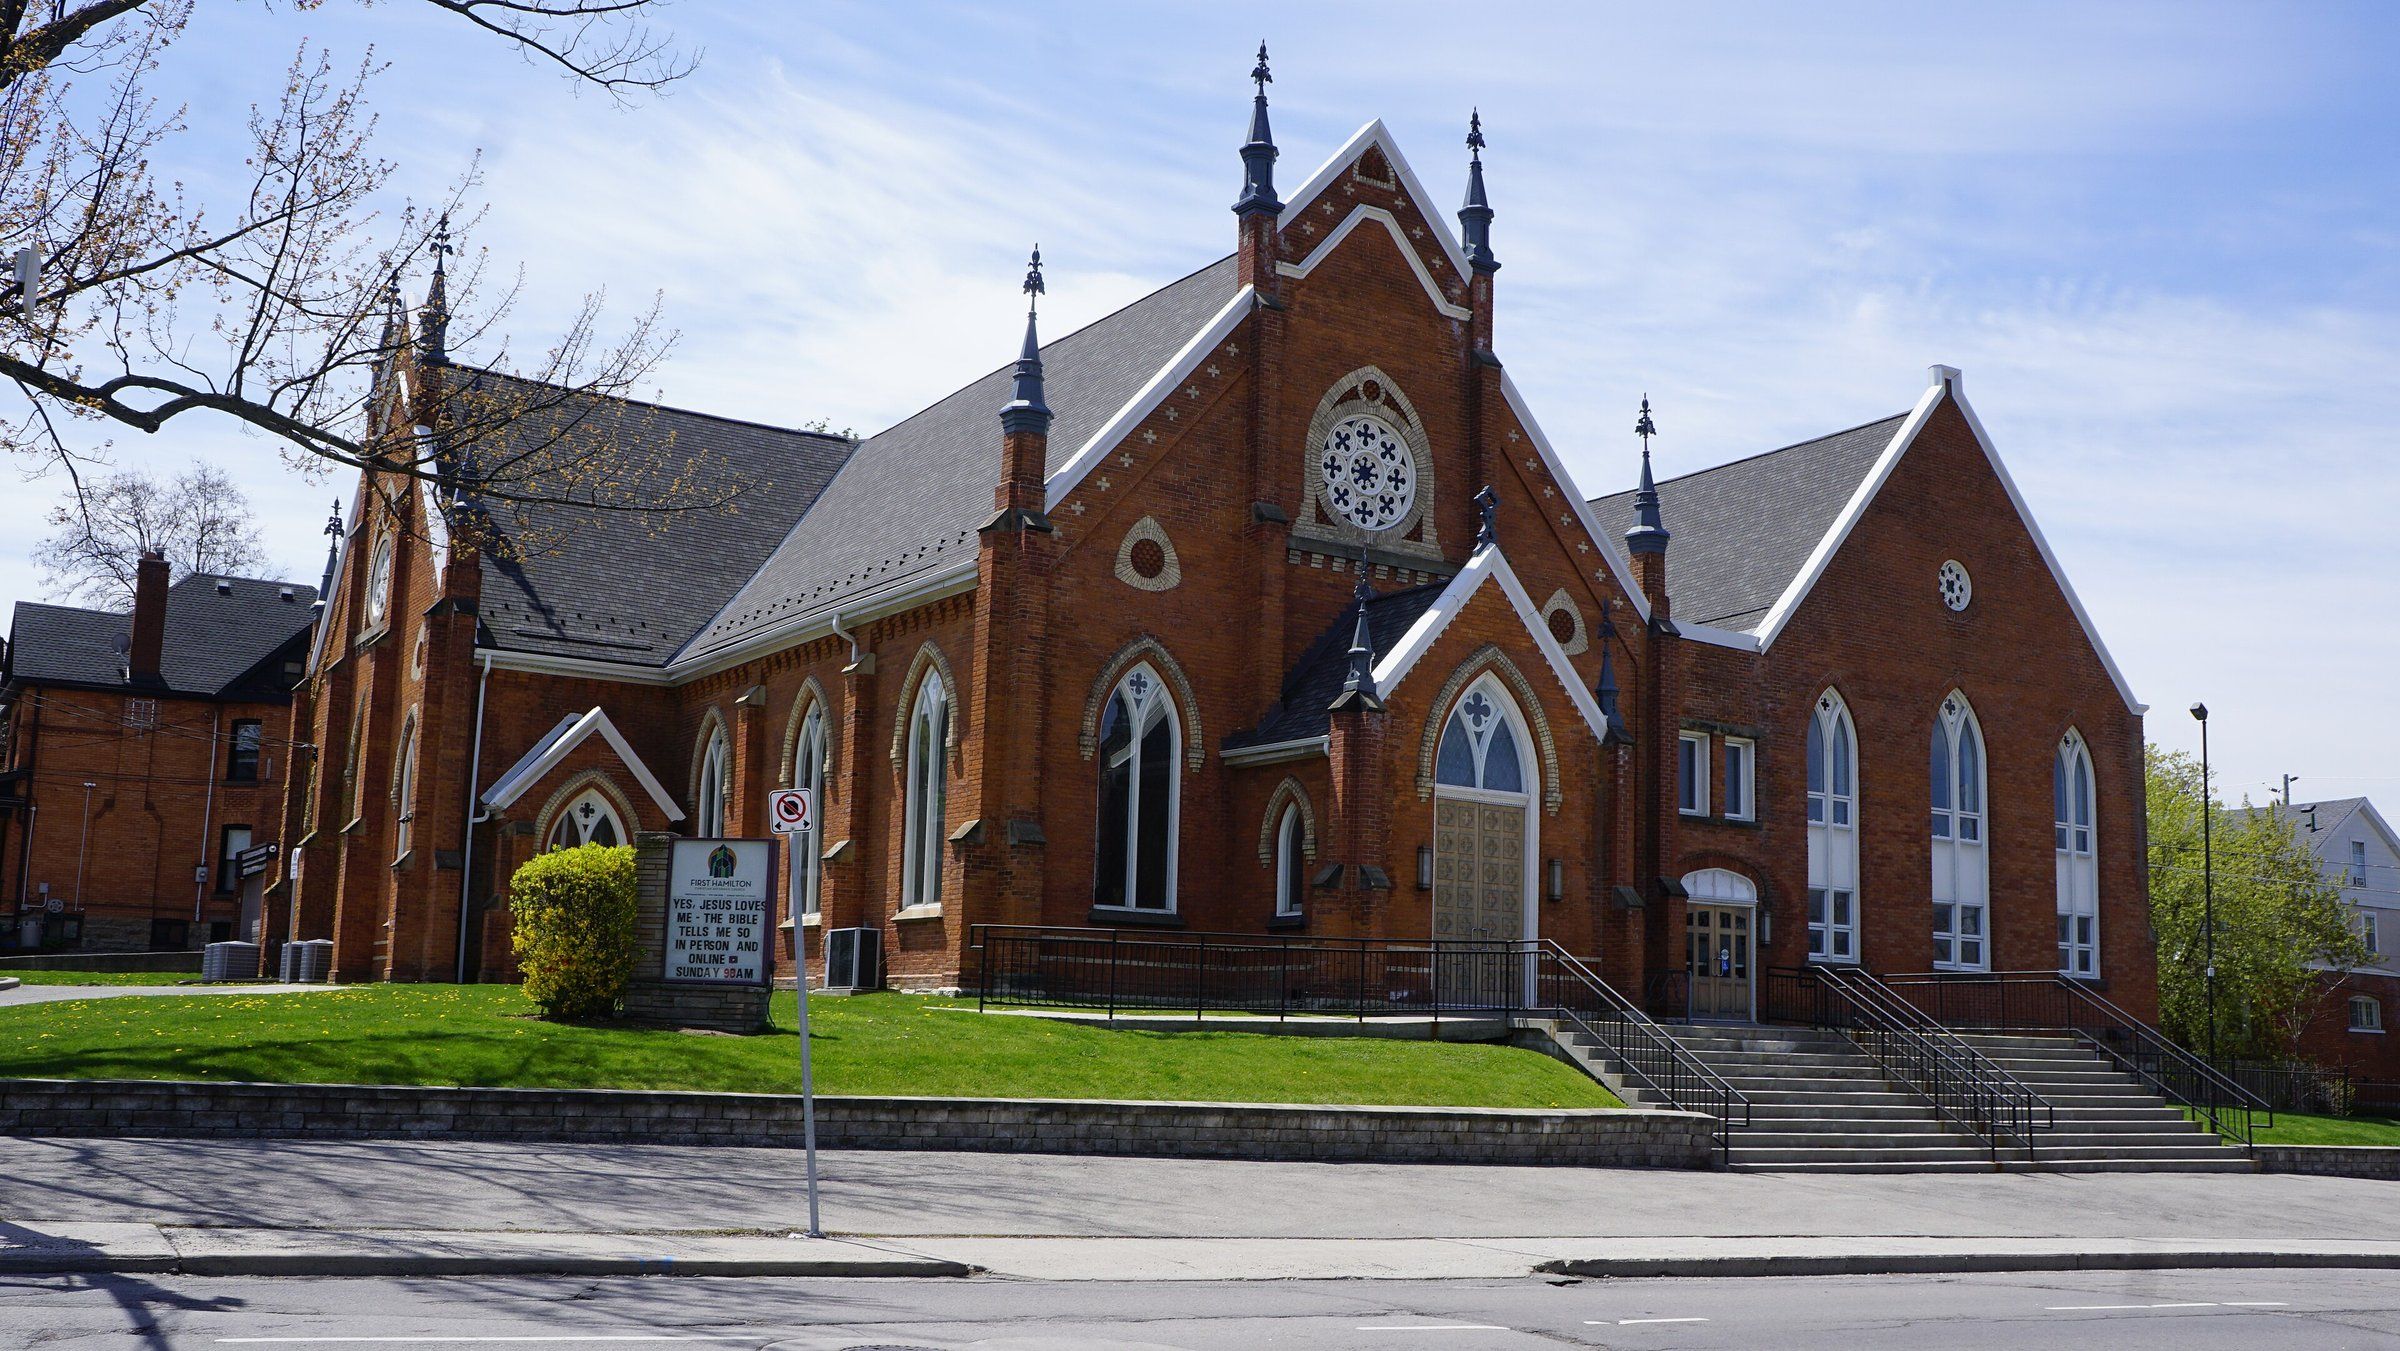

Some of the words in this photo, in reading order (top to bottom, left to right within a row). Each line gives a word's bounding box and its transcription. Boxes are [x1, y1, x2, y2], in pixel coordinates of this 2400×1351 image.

[690, 879, 711, 887] FIRST
[712, 880, 752, 888] HAMILTON
[673, 898, 695, 909] YES,
[700, 899, 732, 910] JESUS
[735, 900, 766, 911] LOVES
[677, 912, 692, 923] ME
[704, 913, 723, 924] THE
[729, 914, 758, 925] BIBLE
[679, 926, 709, 937] TELLS
[716, 927, 731, 937] ME
[737, 927, 750, 938] SO
[675, 939, 686, 950] IN
[690, 940, 729, 951] PERSON
[736, 941, 758, 952] AND
[688, 953, 725, 964] ONLINE
[676, 966, 720, 978] SUNDAY
